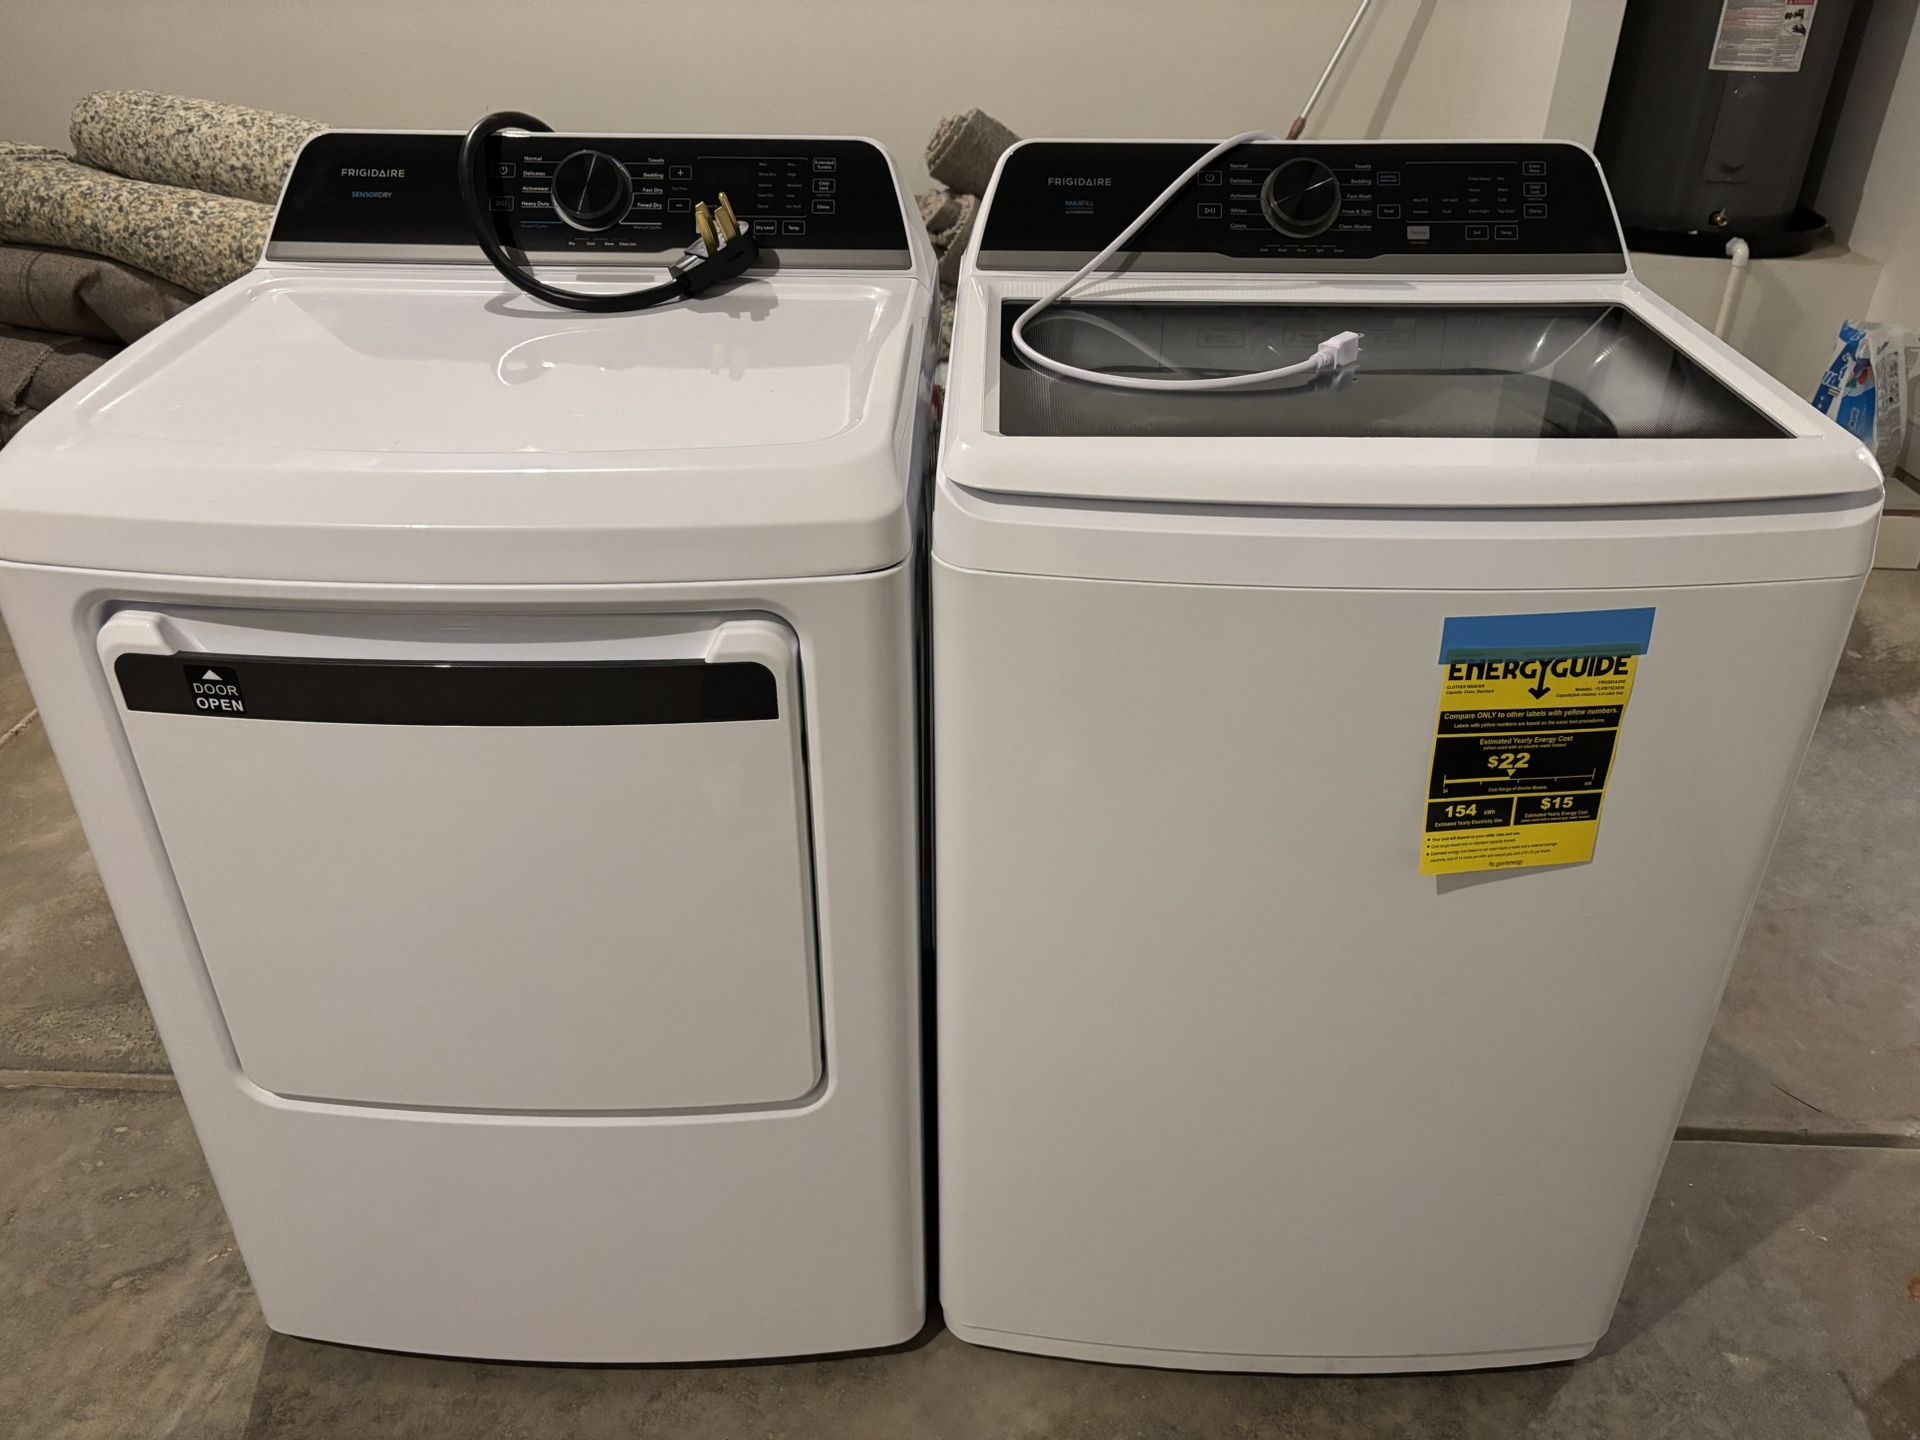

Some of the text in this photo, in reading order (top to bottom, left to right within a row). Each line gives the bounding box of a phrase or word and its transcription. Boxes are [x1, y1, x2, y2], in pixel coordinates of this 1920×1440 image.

[341, 168, 405, 178] FRIGIDAIRE
[1048, 177, 1112, 187] FRIGIDAIRE
[351, 191, 392, 199] SENSORDRY
[1448, 655, 1632, 681] ENERGYGUIDE
[192, 682, 239, 697] DOOR
[195, 697, 244, 712] OPEN
[1444, 707, 1618, 721] Compare ONLY to other labels with yellow numbers.
[1479, 735, 1574, 747] Estimated Yearly Energy Cost
[1487, 752, 1531, 769] $22
[1444, 803, 1477, 818] 154
[1540, 796, 1574, 811] $15
[1483, 808, 1496, 816] kWh
[1457, 819, 1471, 827] Yearly
[1471, 818, 1493, 826] Electricity
